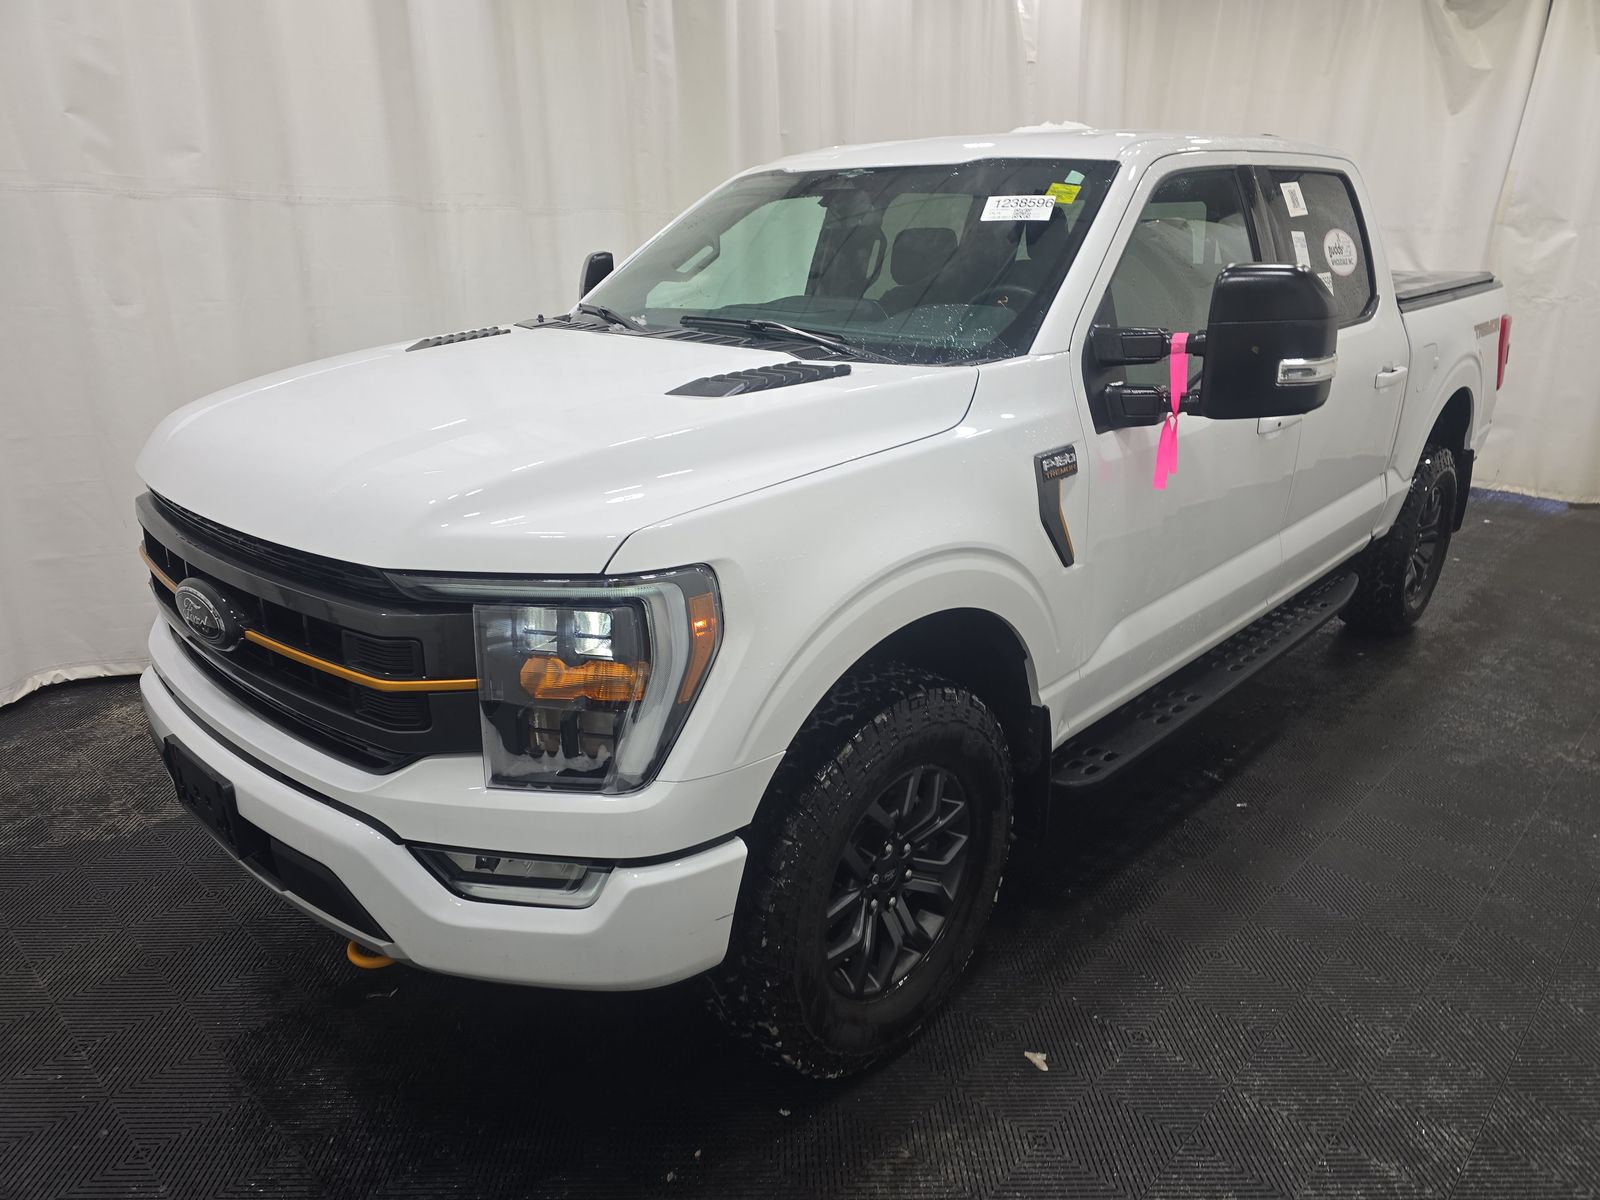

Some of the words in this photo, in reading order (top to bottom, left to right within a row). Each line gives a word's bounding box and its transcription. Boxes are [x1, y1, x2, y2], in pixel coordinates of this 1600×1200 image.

[995, 197, 1056, 209] 1238596
[1042, 452, 1076, 472] F-150
[1044, 463, 1077, 479] TREMOR
[183, 597, 209, 628] Ford
